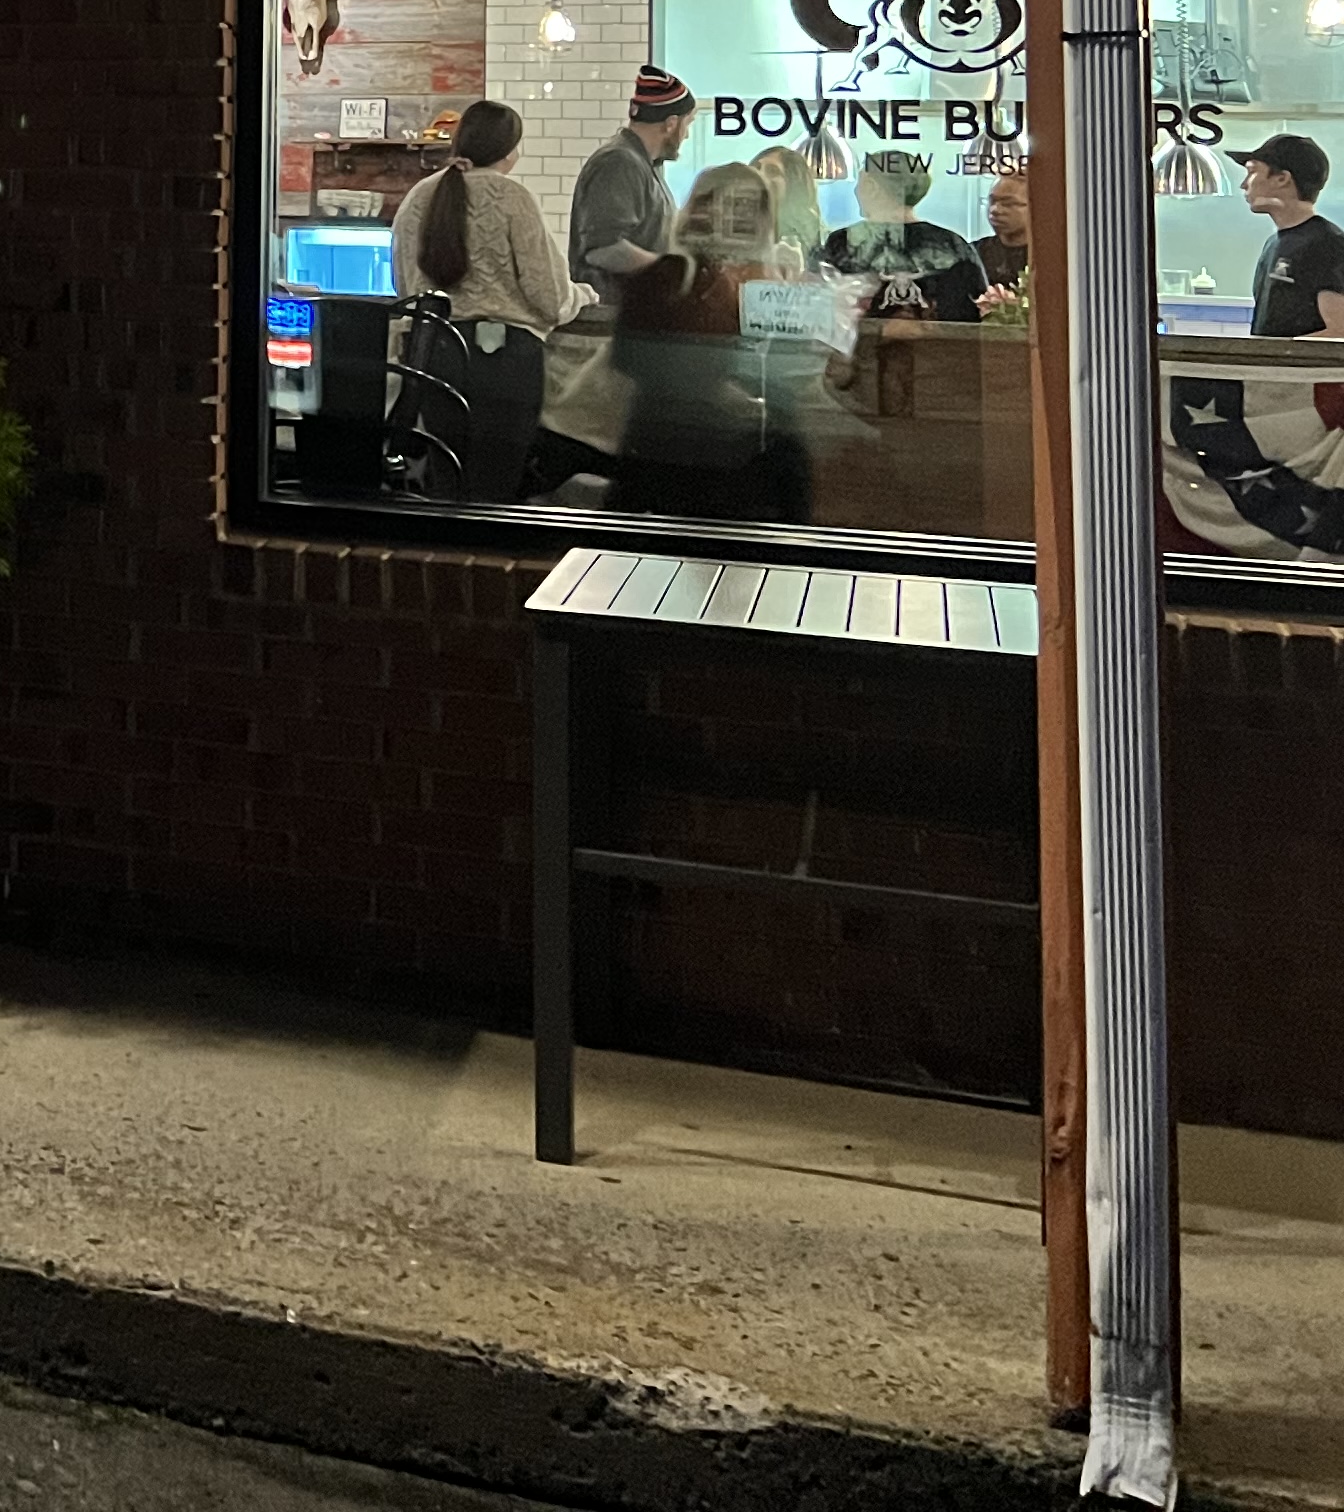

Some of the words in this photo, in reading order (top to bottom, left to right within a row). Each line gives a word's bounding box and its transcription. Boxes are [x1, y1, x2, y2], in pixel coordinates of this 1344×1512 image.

[714, 97, 921, 139] BOVINE
[945, 100, 1224, 146] BURS
[864, 152, 933, 174] NEW
